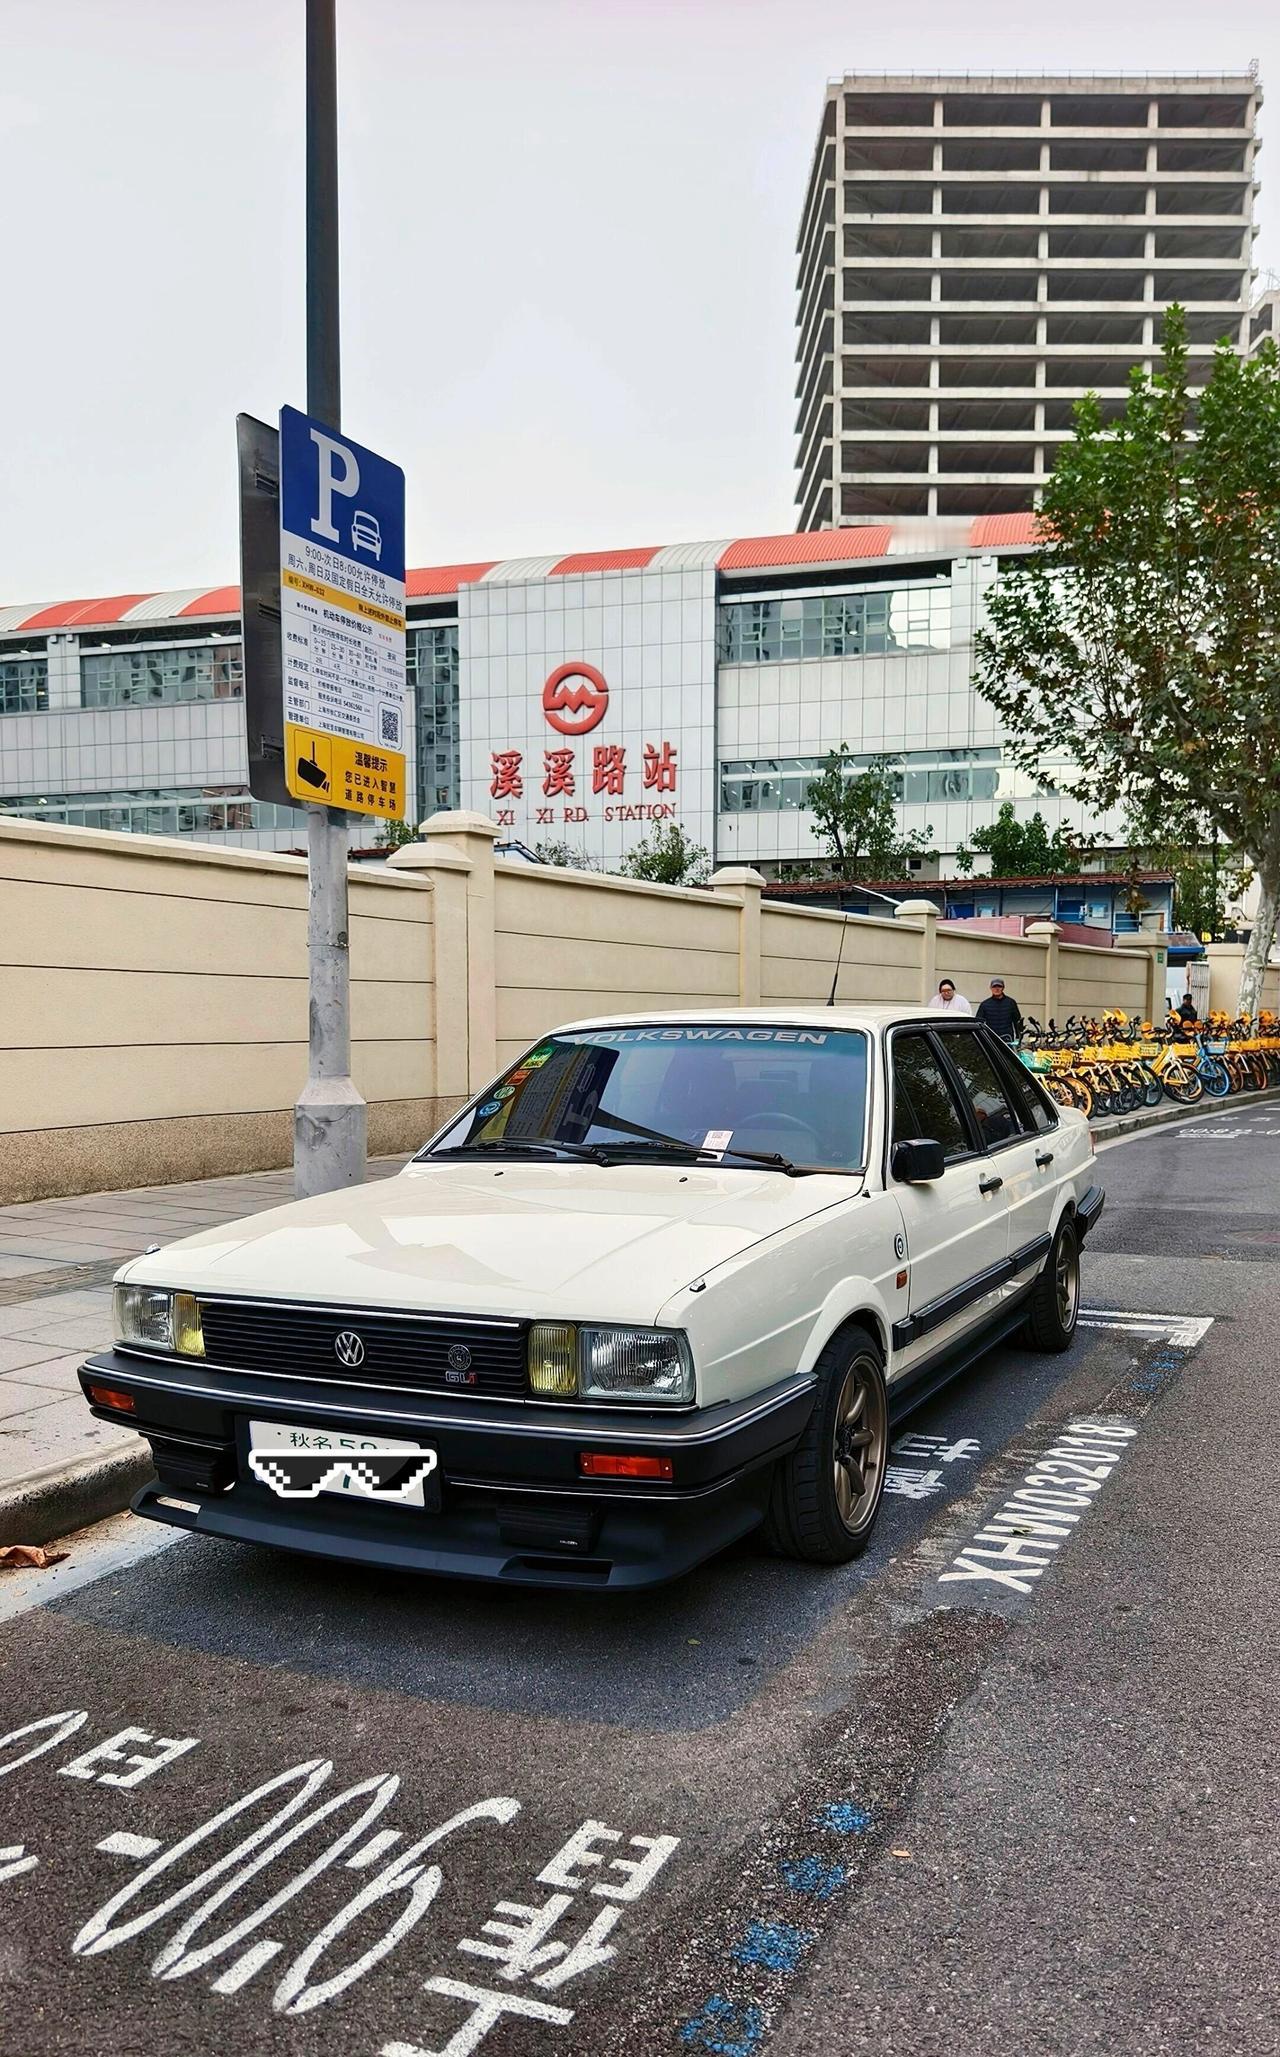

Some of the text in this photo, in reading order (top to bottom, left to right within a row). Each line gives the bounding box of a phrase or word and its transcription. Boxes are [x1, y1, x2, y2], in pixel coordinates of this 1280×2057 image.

[310, 427, 361, 544] P
[354, 751, 388, 772] 温馨提示
[490, 741, 677, 799] 溪溪路站
[344, 771, 397, 794] 您已进入智慧
[344, 789, 397, 811] 道路停车场
[496, 809, 516, 826] XI
[536, 808, 555, 824] XI
[605, 803, 677, 822] STATION
[571, 1029, 828, 1045] VOLKSWAGEN
[938, 1424, 1138, 1594] XHW032018
